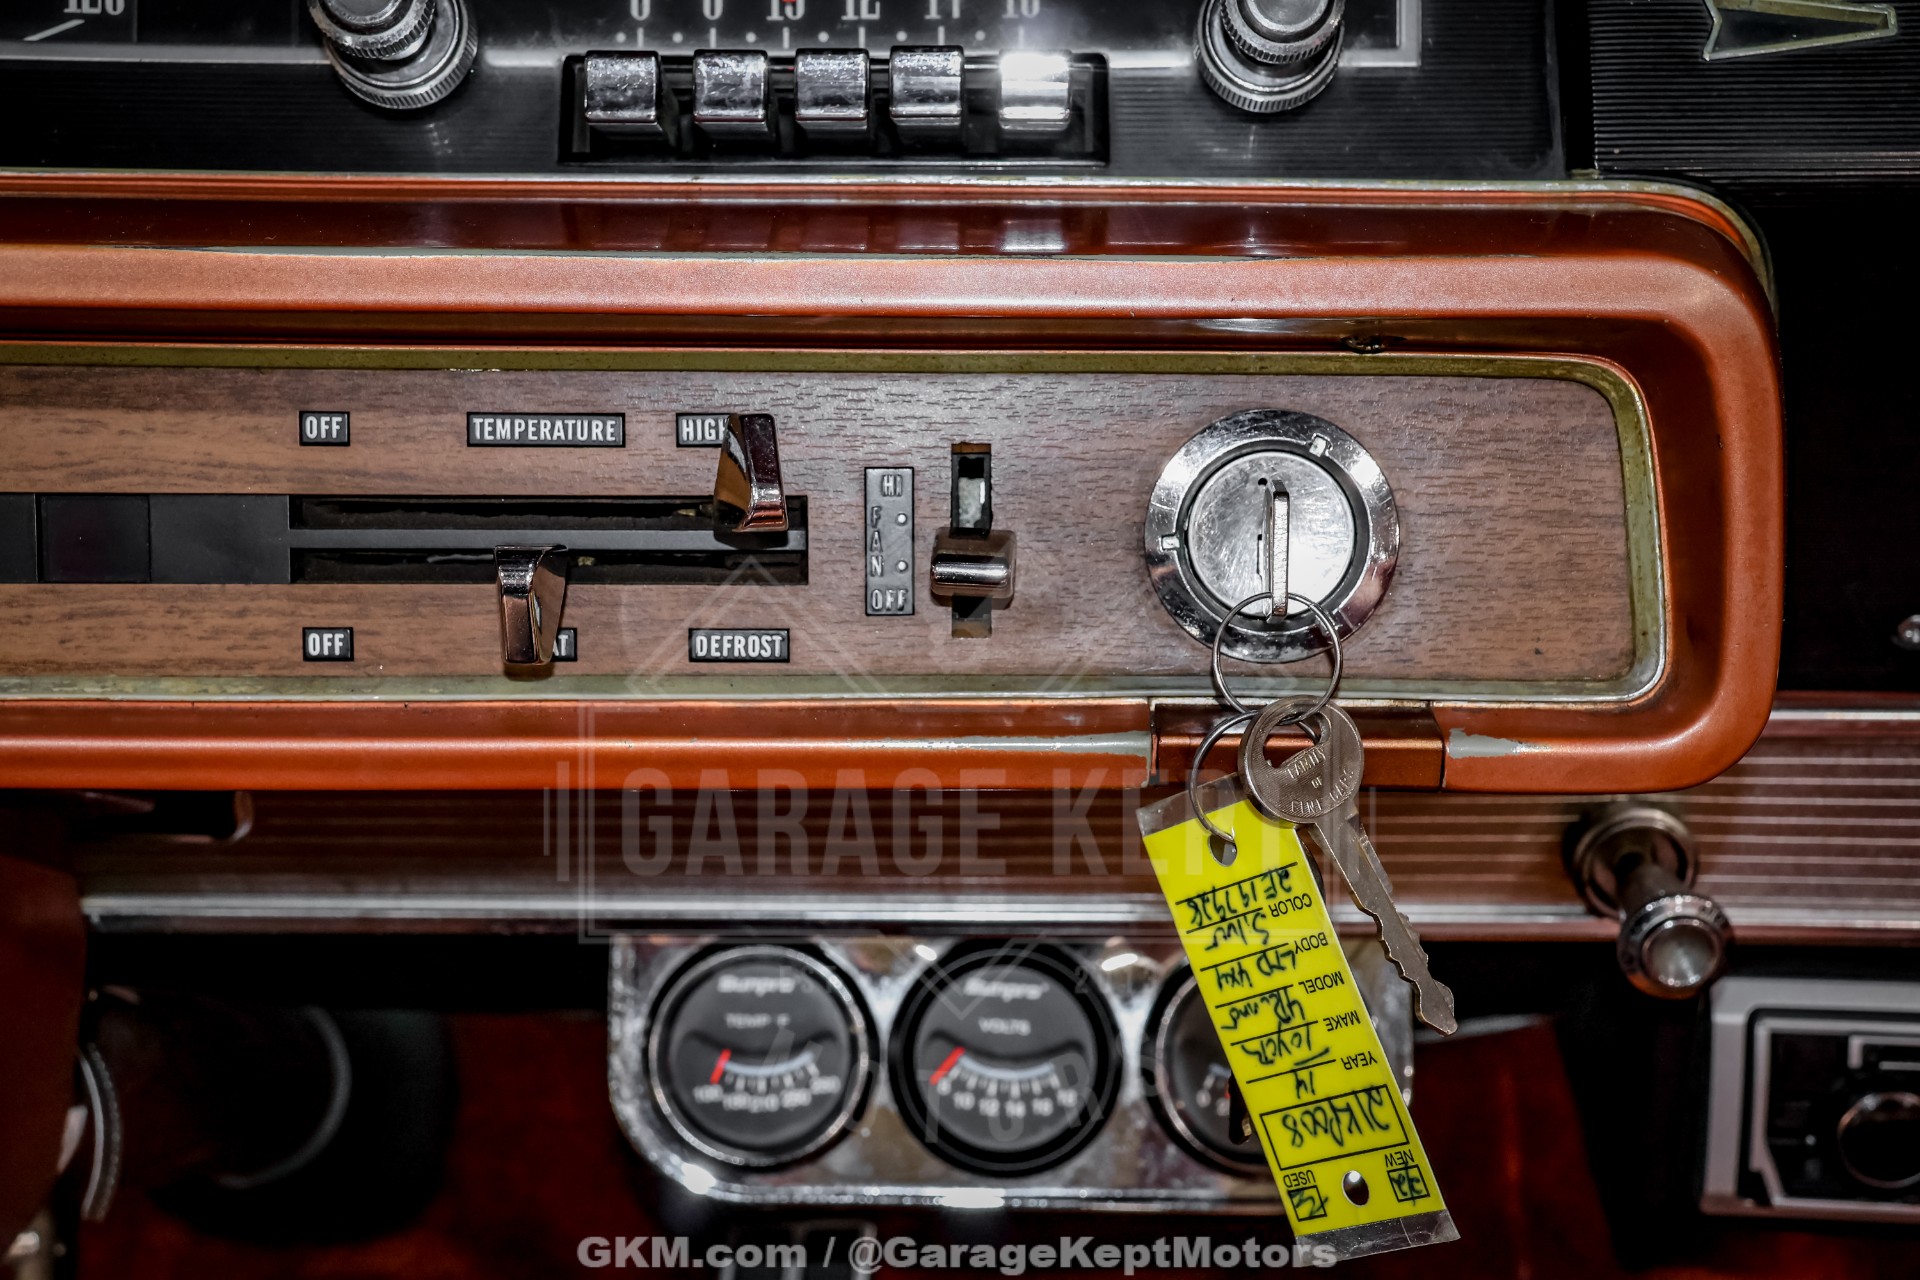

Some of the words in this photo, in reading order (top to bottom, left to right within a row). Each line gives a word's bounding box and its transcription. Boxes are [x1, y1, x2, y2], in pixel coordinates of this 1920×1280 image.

[304, 415, 343, 439] OFF
[472, 417, 617, 442] TEMPERATURE
[882, 474, 902, 498] HI
[870, 588, 909, 612] OFF
[307, 633, 345, 657] OFF
[695, 634, 783, 658] DEFROST
[1268, 892, 1313, 918] COLOR
[1294, 931, 1329, 955] BODY
[1298, 970, 1346, 994] MODEL
[1322, 1010, 1362, 1032] MAKE
[1340, 1051, 1378, 1071] YEAR
[1384, 1149, 1415, 1168] NEW
[1282, 1169, 1317, 1189] USED
